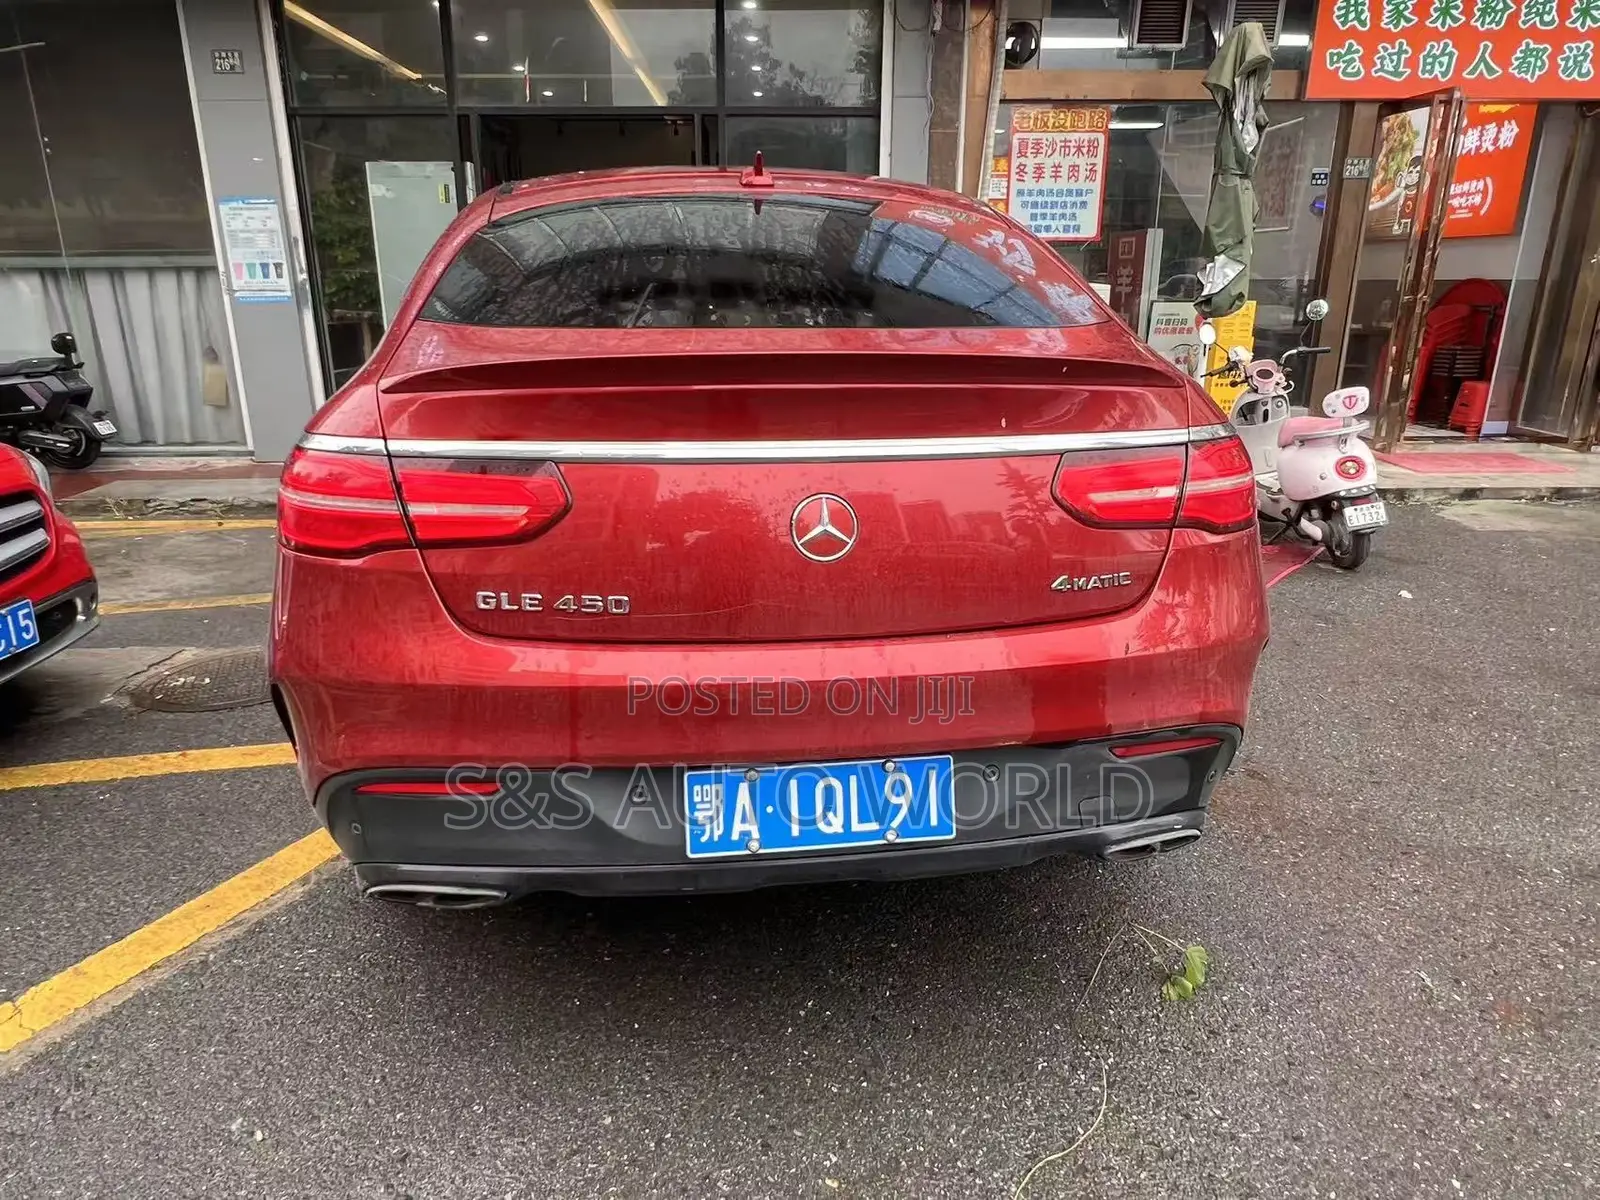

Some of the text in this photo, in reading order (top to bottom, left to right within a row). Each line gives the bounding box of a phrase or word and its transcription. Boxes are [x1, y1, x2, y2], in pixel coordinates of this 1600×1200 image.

[1326, 39, 1594, 81] 吃过的人都说
[1013, 108, 1107, 130] 老板没跑路
[1016, 137, 1099, 159] 夏季沙市米粉
[1457, 117, 1519, 157] 鲜烫粉
[1015, 162, 1098, 183] 冬季羊肉汤
[1050, 571, 1132, 592] 4MATIC
[476, 591, 630, 614] GLE 450
[0, 608, 35, 652] 15
